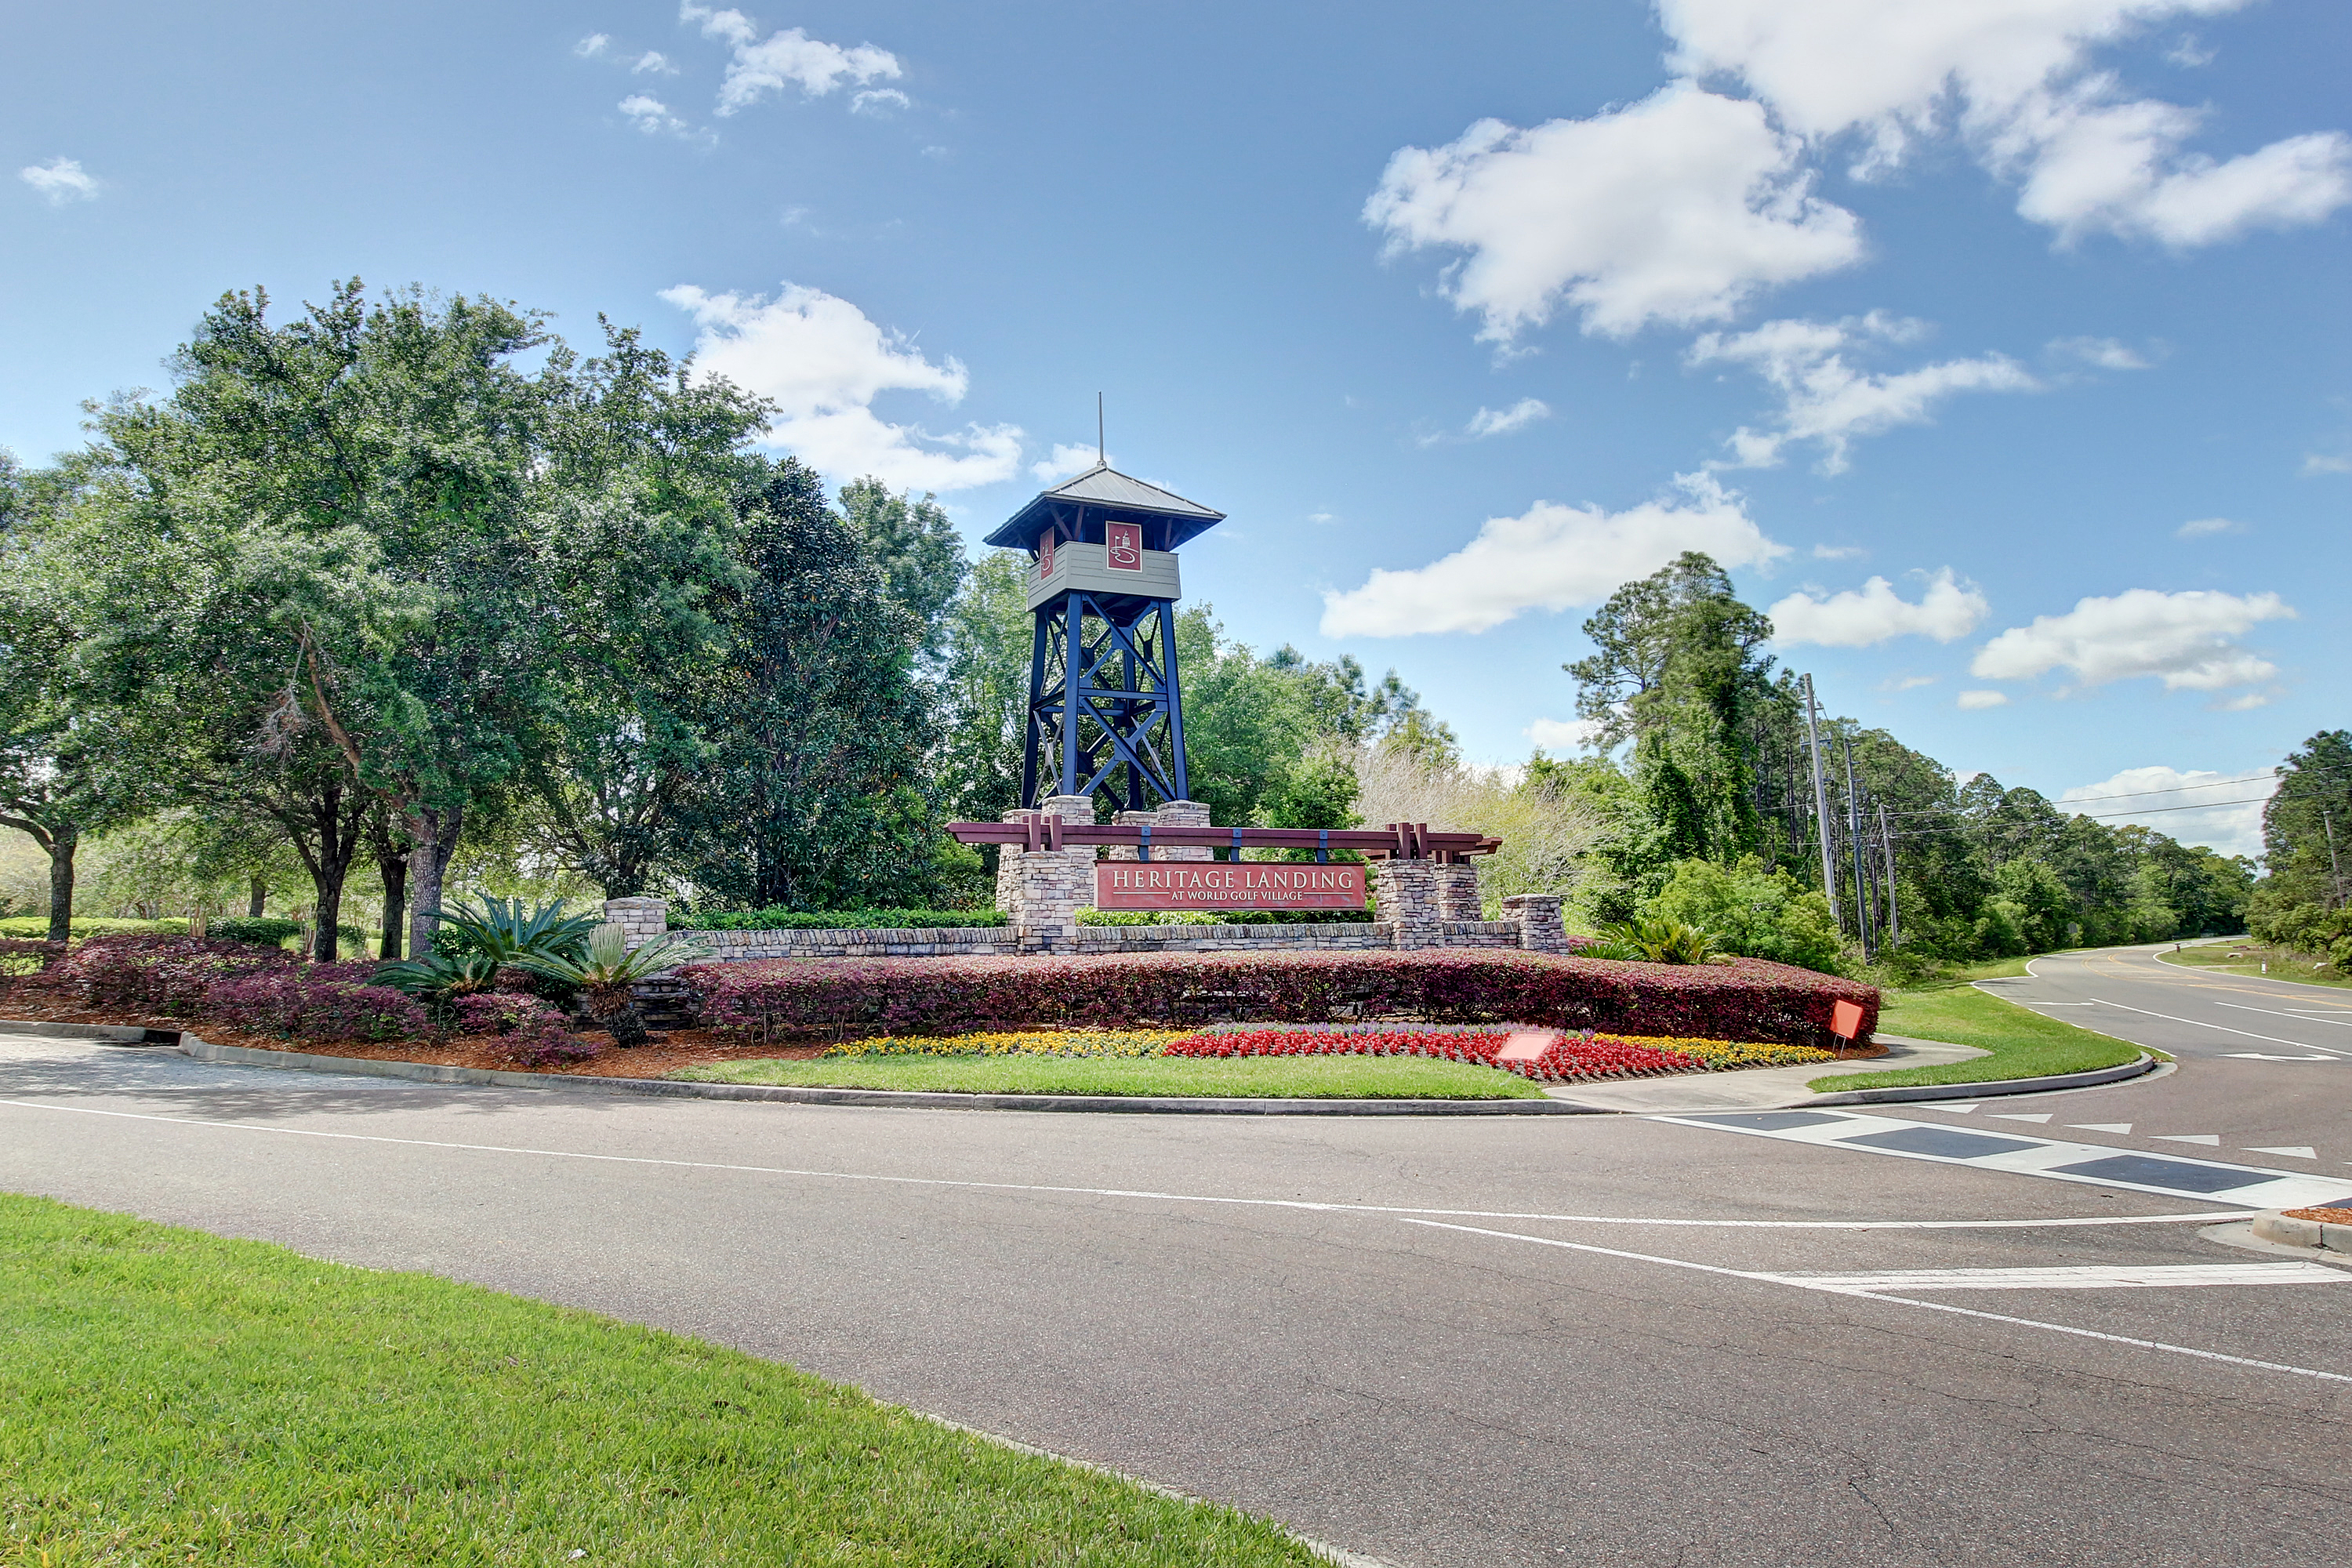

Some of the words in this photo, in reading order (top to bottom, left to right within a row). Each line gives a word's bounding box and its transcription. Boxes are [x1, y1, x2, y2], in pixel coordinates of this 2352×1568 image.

[1112, 870, 1235, 889] HERITAGE
[1246, 871, 1353, 890] LANDING
[1171, 891, 1184, 901] AT
[1188, 891, 1227, 901] WORLD
[1230, 891, 1258, 901] GOLF
[1262, 891, 1303, 901] VILLAGE
